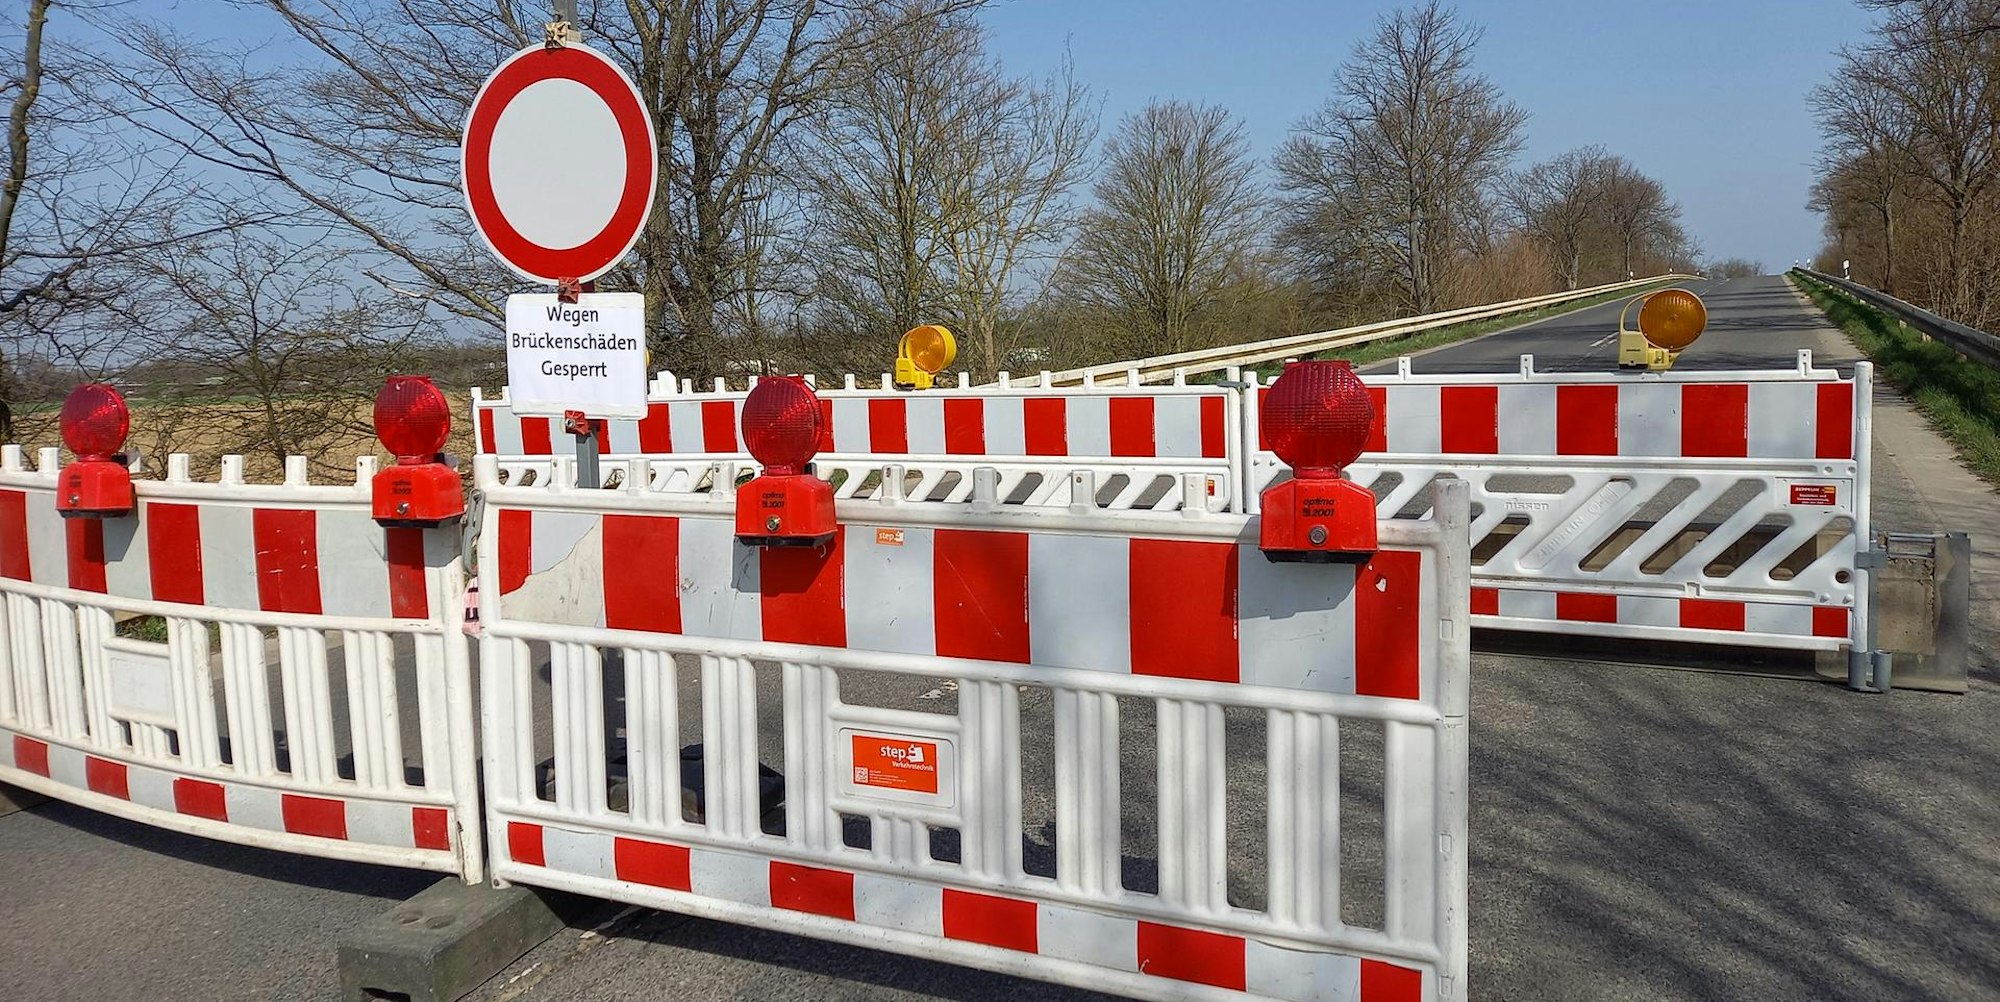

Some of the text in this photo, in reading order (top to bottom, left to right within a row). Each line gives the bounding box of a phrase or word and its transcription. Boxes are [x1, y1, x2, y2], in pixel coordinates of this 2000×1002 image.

[546, 306, 599, 327] Wegen
[511, 332, 637, 350] Brückenschäden
[541, 360, 607, 381] Gesperrt
[1303, 497, 1334, 507] optima
[1503, 497, 1549, 511] nissen
[878, 532, 894, 542] step
[880, 745, 906, 761] step
